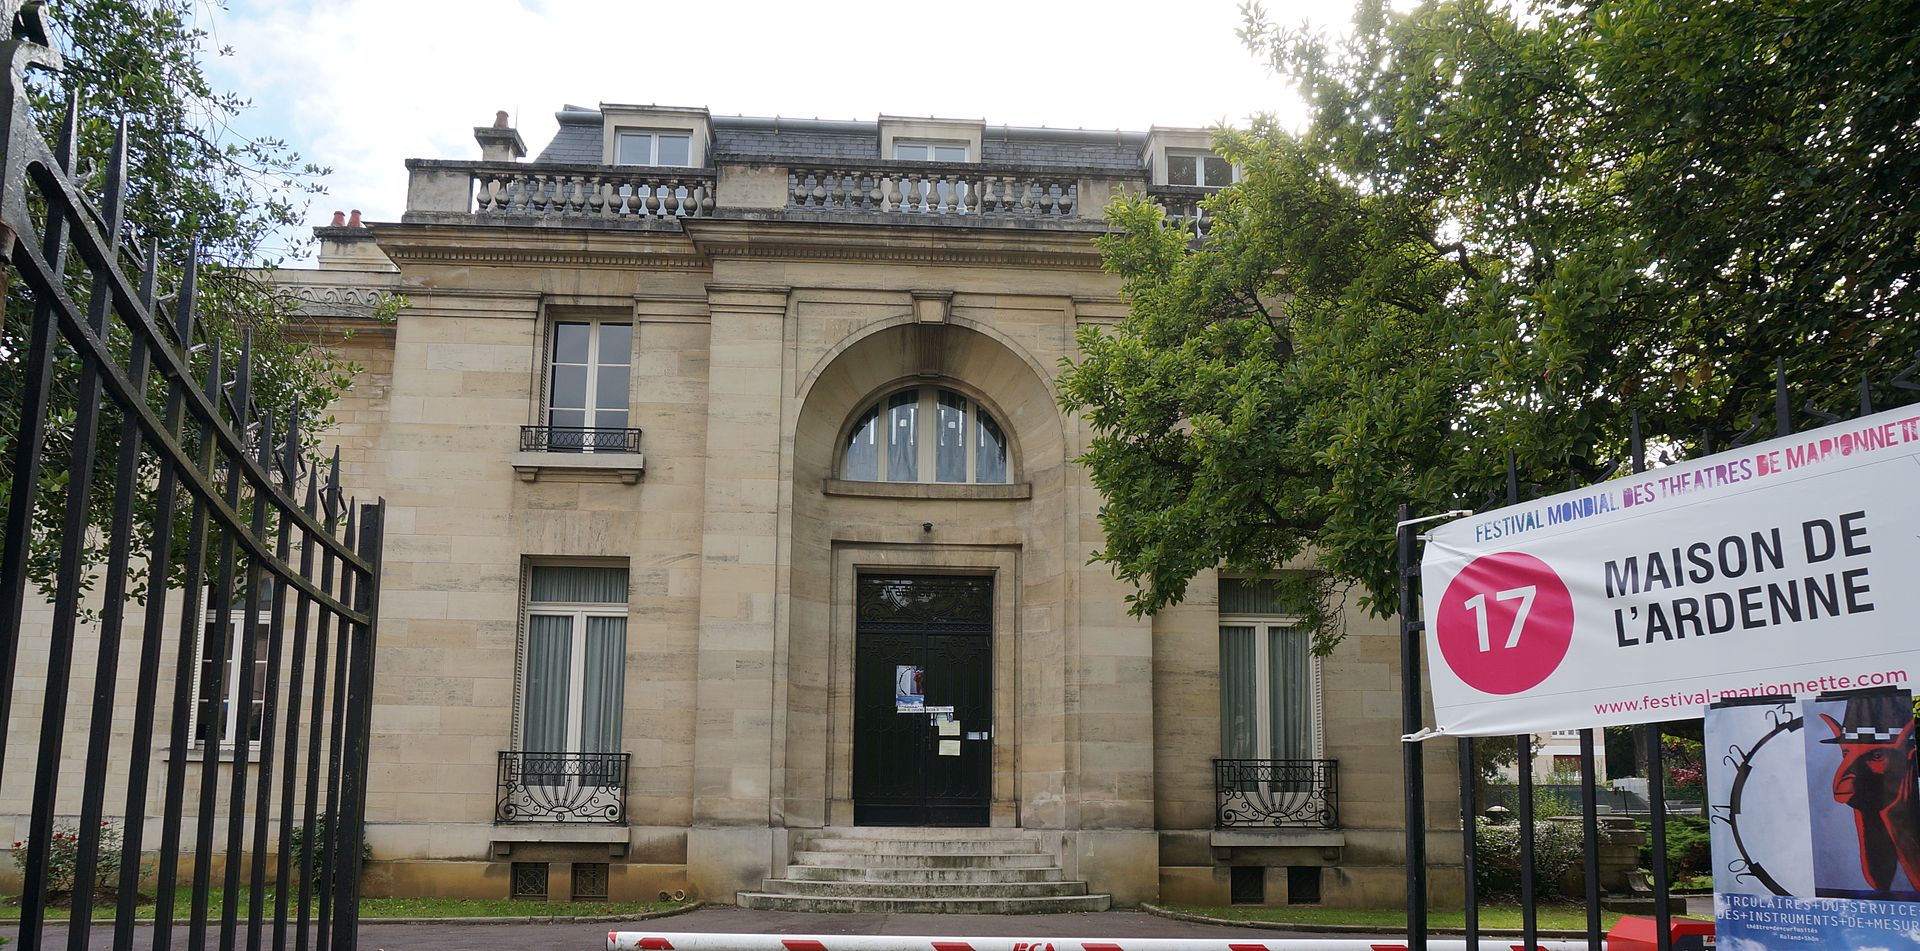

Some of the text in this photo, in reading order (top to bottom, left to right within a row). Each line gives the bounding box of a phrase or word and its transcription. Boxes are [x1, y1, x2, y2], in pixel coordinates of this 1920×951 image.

[1475, 510, 1544, 543] FESTIVAL
[1548, 492, 1620, 525] MONDIAL
[1623, 482, 1655, 508] DES
[1658, 459, 1753, 498] THEATRES
[1756, 451, 1782, 476] DE
[1603, 510, 1871, 599] MAISON DE
[1464, 585, 1537, 653] 17
[1614, 567, 1875, 647] L'ARDENNE
[1594, 668, 1908, 715] www.festival-marionnette.com
